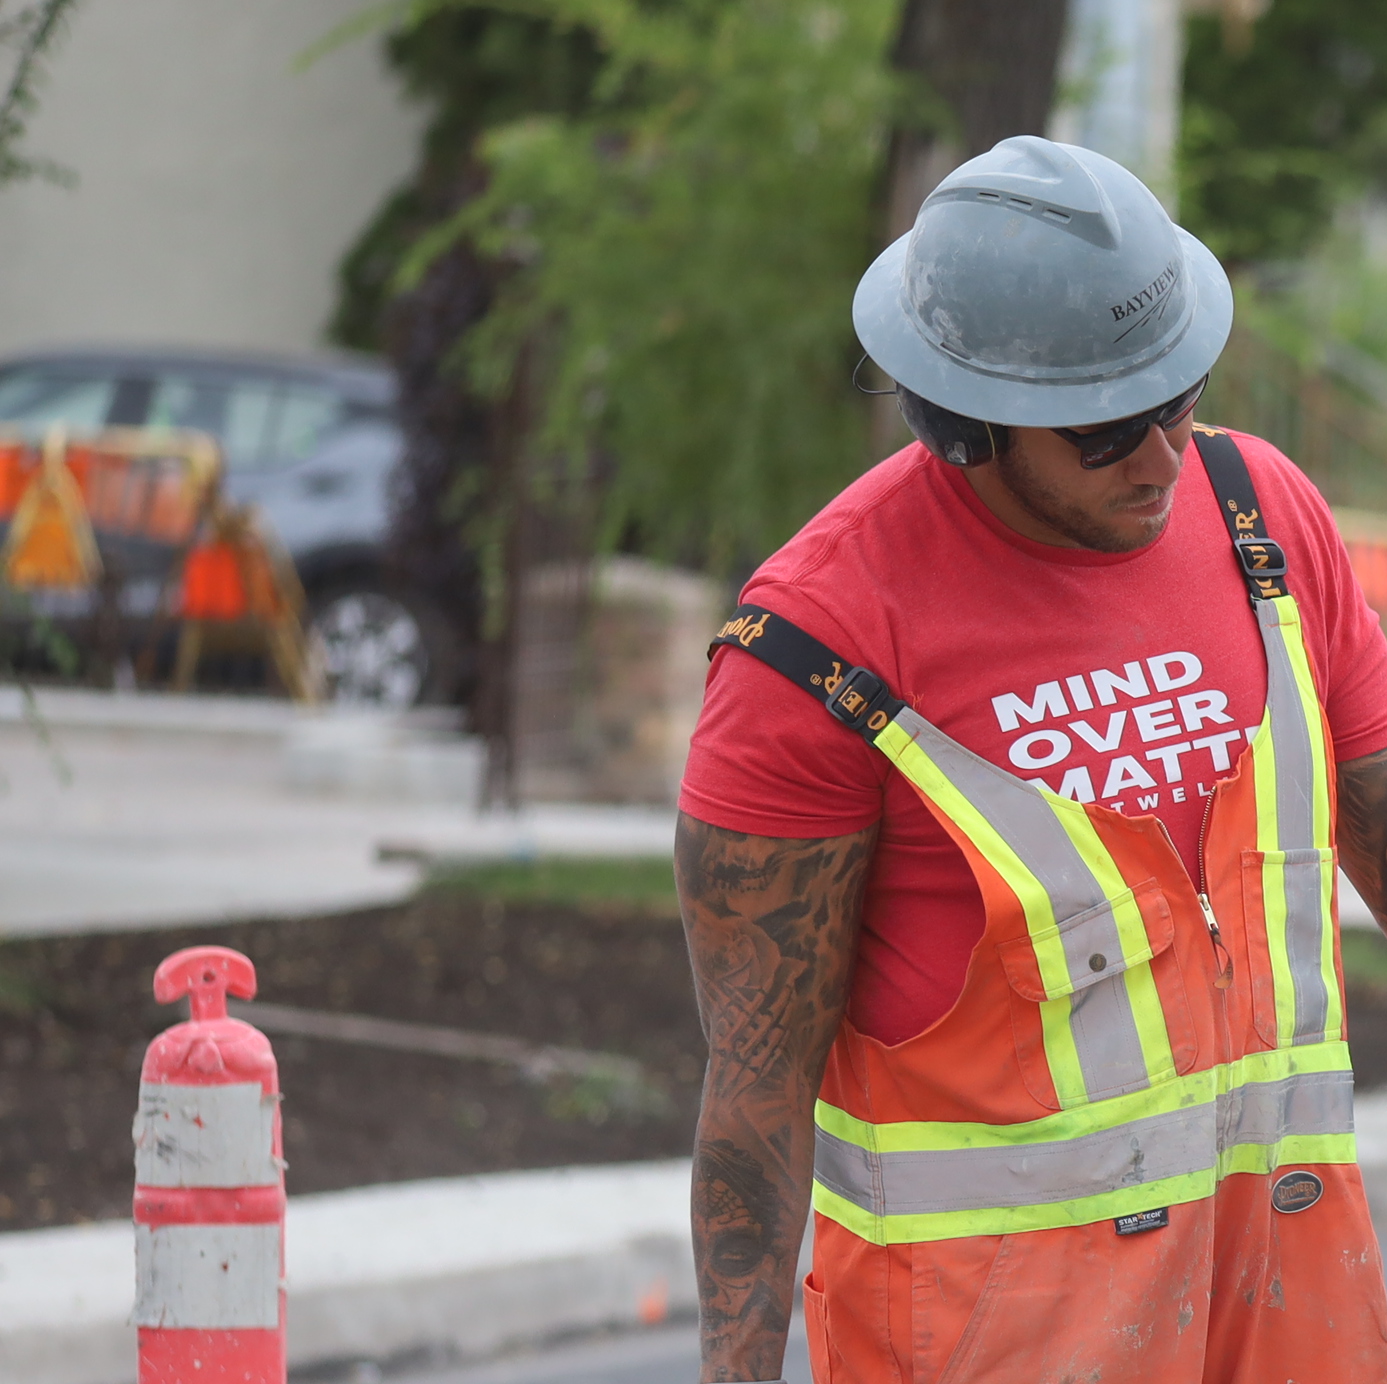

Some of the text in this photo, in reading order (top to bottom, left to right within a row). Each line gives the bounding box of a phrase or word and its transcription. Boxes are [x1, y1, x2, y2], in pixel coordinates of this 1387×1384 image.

[1109, 260, 1176, 322] BAYVIEW
[991, 650, 1204, 733] MIND
[1008, 689, 1235, 770] OVER
[1118, 1216, 1139, 1226] STAR
